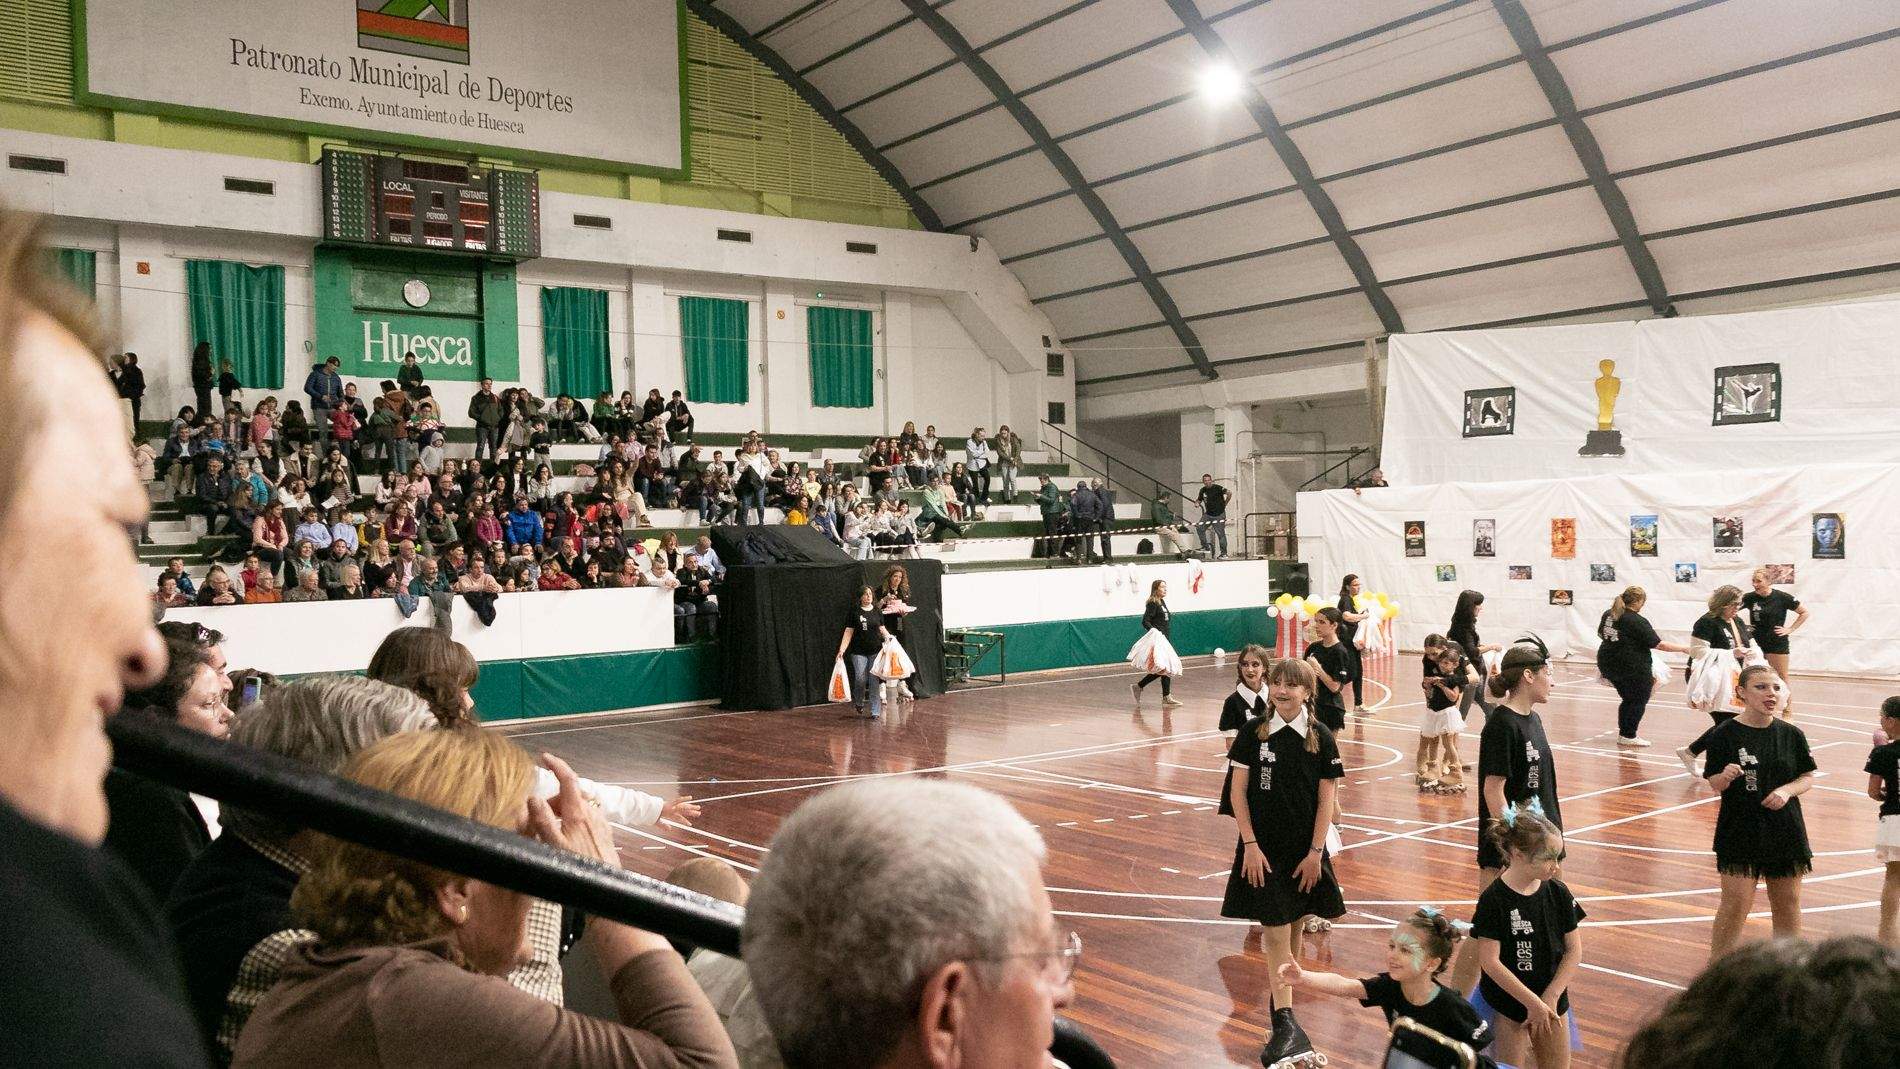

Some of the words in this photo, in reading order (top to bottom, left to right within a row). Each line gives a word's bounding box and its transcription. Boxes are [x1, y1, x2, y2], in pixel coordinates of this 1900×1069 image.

[229, 38, 342, 80] Patronato
[349, 56, 450, 99] Municipal
[458, 72, 481, 100] de
[487, 76, 574, 114] Deportes
[299, 86, 354, 112] Excmo.
[357, 95, 457, 126] Ayuntamiento
[459, 109, 475, 128] de
[477, 111, 525, 135] Huesca
[383, 181, 414, 192] LOCAL
[459, 189, 489, 201] VISITANTE
[361, 320, 473, 366] Huesca
[1516, 948, 1533, 959] es
[1517, 961, 1533, 971] ca
